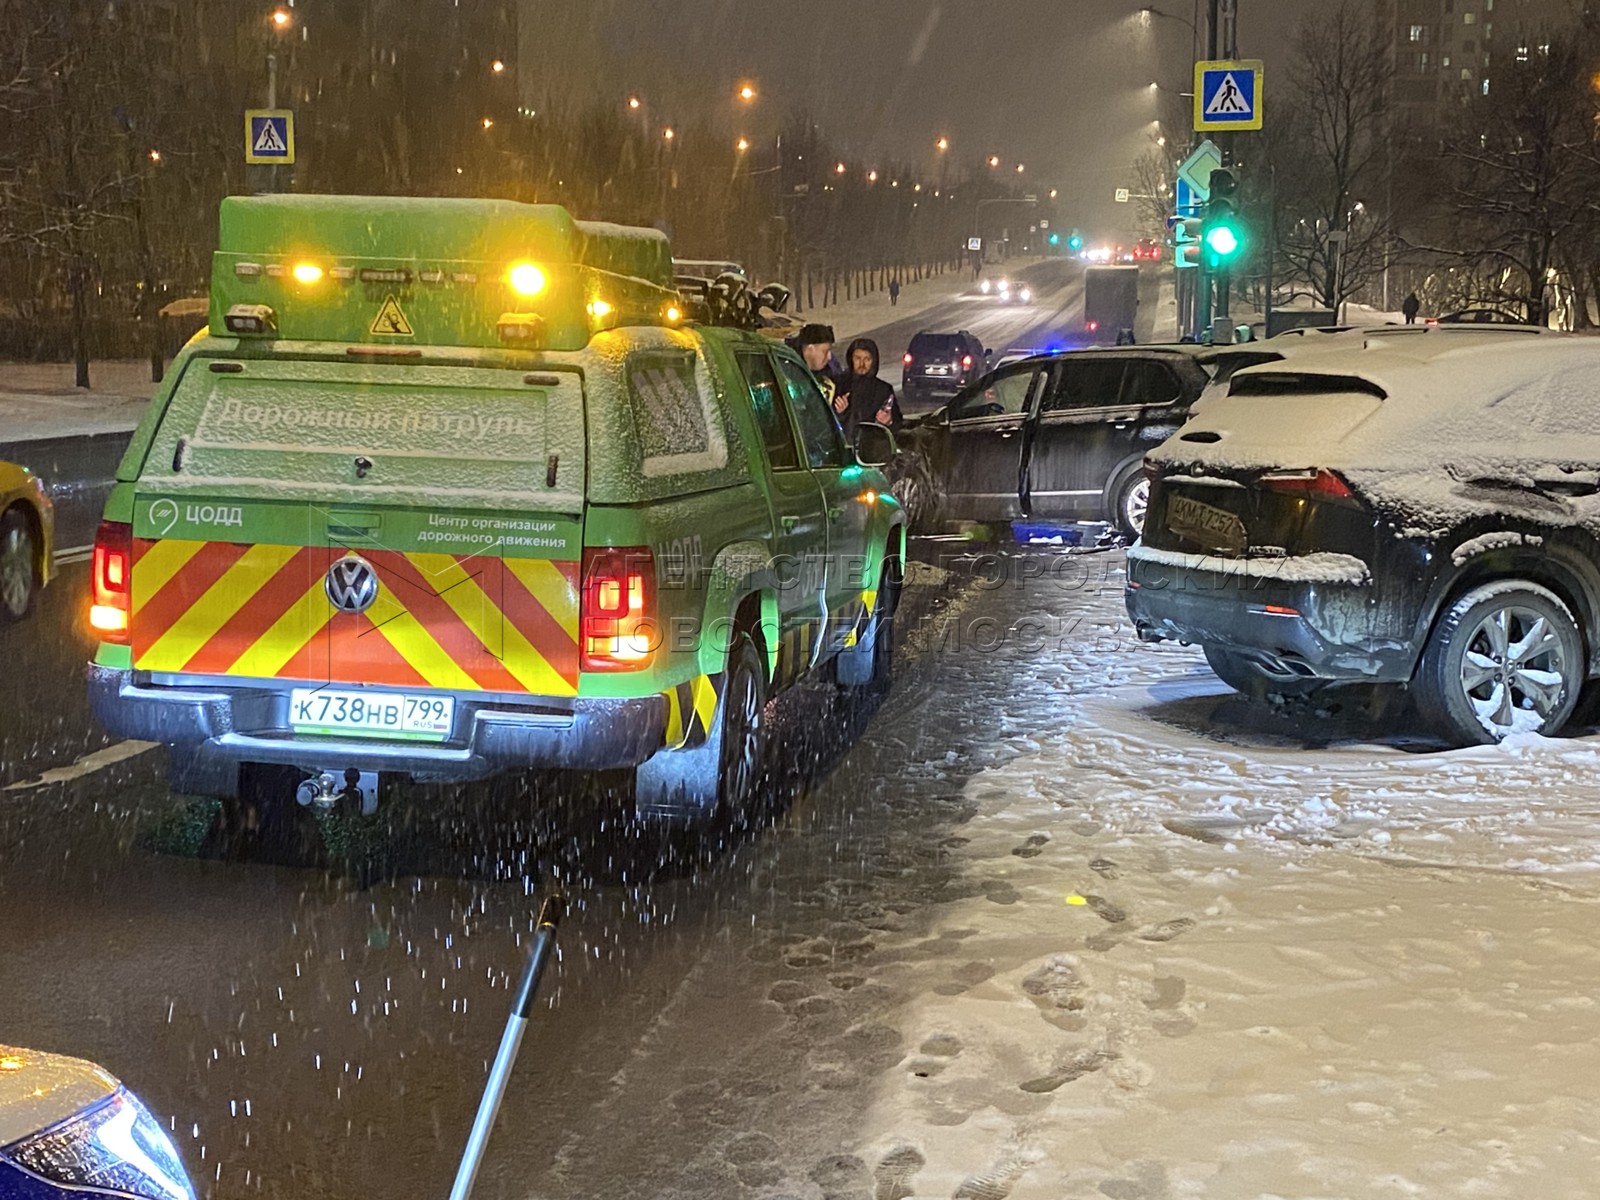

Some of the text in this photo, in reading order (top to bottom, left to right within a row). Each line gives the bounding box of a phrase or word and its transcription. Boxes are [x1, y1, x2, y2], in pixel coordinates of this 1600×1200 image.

[217, 398, 533, 439] Дорожный патруль
[185, 505, 243, 527] ЦОДД
[428, 513, 556, 532] Центр организации
[417, 530, 566, 548] дорожного движения
[406, 698, 445, 721] 799
[413, 719, 433, 730] RUS
